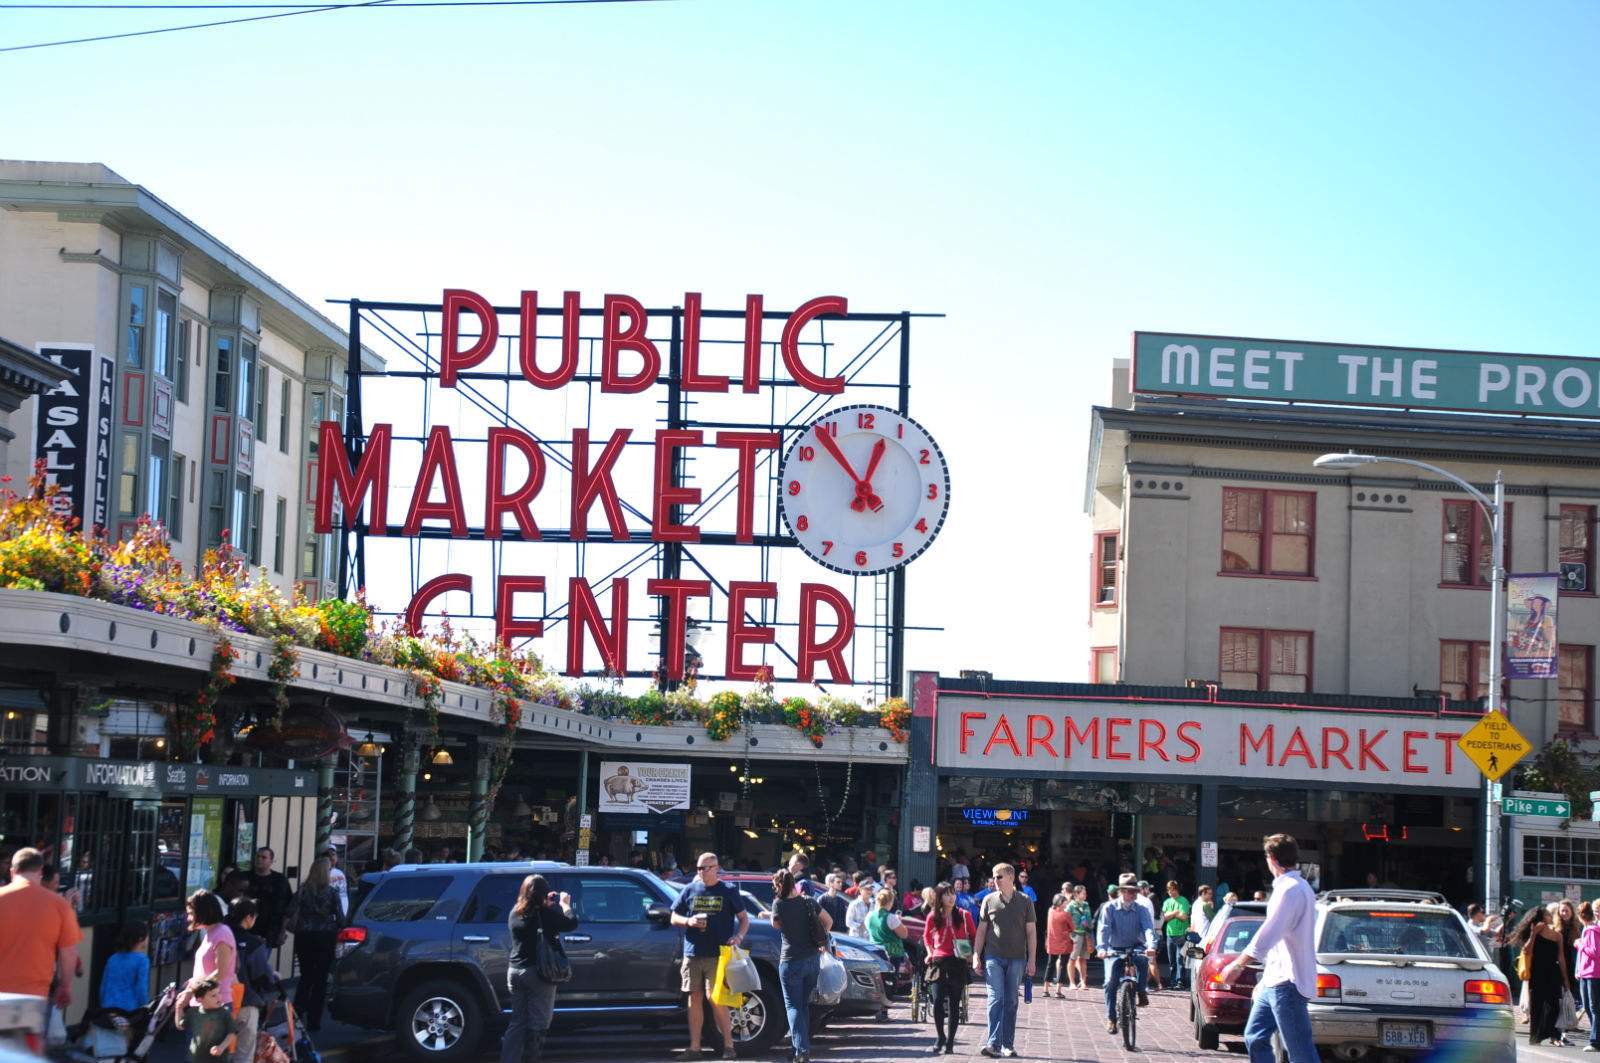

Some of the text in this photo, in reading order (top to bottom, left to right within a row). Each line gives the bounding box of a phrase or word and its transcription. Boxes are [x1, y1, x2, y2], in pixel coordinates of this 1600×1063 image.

[439, 288, 849, 396] PUBLIC
[1160, 343, 1600, 410] MEET THE PRO
[857, 413, 875, 430] 12
[897, 423, 903, 439] 1
[95, 362, 112, 524] LA SALLE
[798, 446, 815, 462] 10
[919, 449, 931, 465] 2
[313, 420, 782, 546] MARKET
[788, 480, 801, 496] 9
[927, 484, 938, 500] 3
[796, 515, 809, 532] 8
[914, 518, 928, 534] 4
[821, 541, 834, 556] 7
[892, 543, 904, 558] 5
[854, 551, 868, 567] 6
[405, 572, 856, 685] CENTER
[1482, 720, 1508, 731] YIELD
[959, 710, 1461, 776] FARMERS MARKET
[1489, 731, 1500, 741] TO
[1466, 740, 1522, 752] PEDESTRIANS
[86, 763, 144, 786] INFORMATION
[218, 773, 250, 786] INFORMATION
[962, 808, 1029, 820] VIEWPNT
[1506, 799, 1533, 813] Pike
